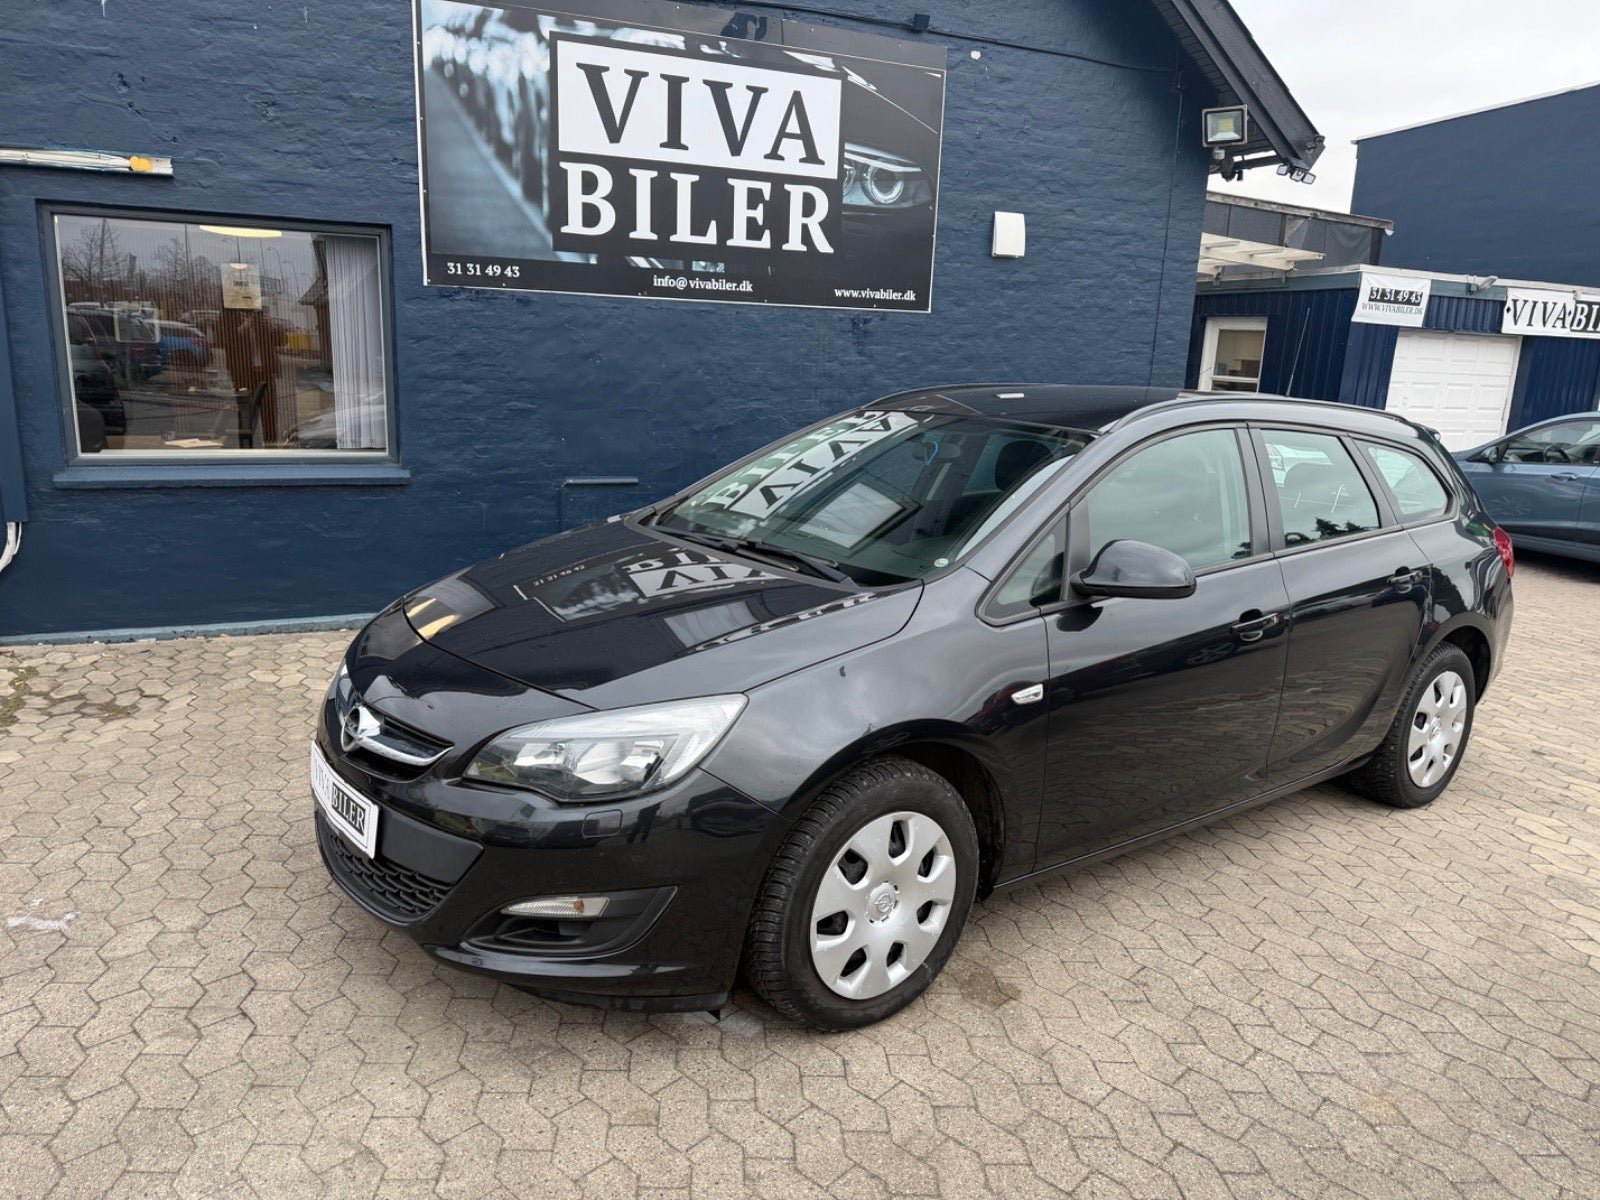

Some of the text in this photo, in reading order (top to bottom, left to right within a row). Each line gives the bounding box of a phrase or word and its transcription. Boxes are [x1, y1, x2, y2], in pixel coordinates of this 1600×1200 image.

[576, 62, 826, 166] VIVA
[559, 161, 835, 254] BILER
[447, 262, 520, 278] 31 31 49 43
[834, 287, 917, 302] www.vivabiler.dk
[1370, 287, 1423, 304] 31 31 49 43
[1570, 303, 1600, 332] BI
[333, 785, 365, 833] BILER
